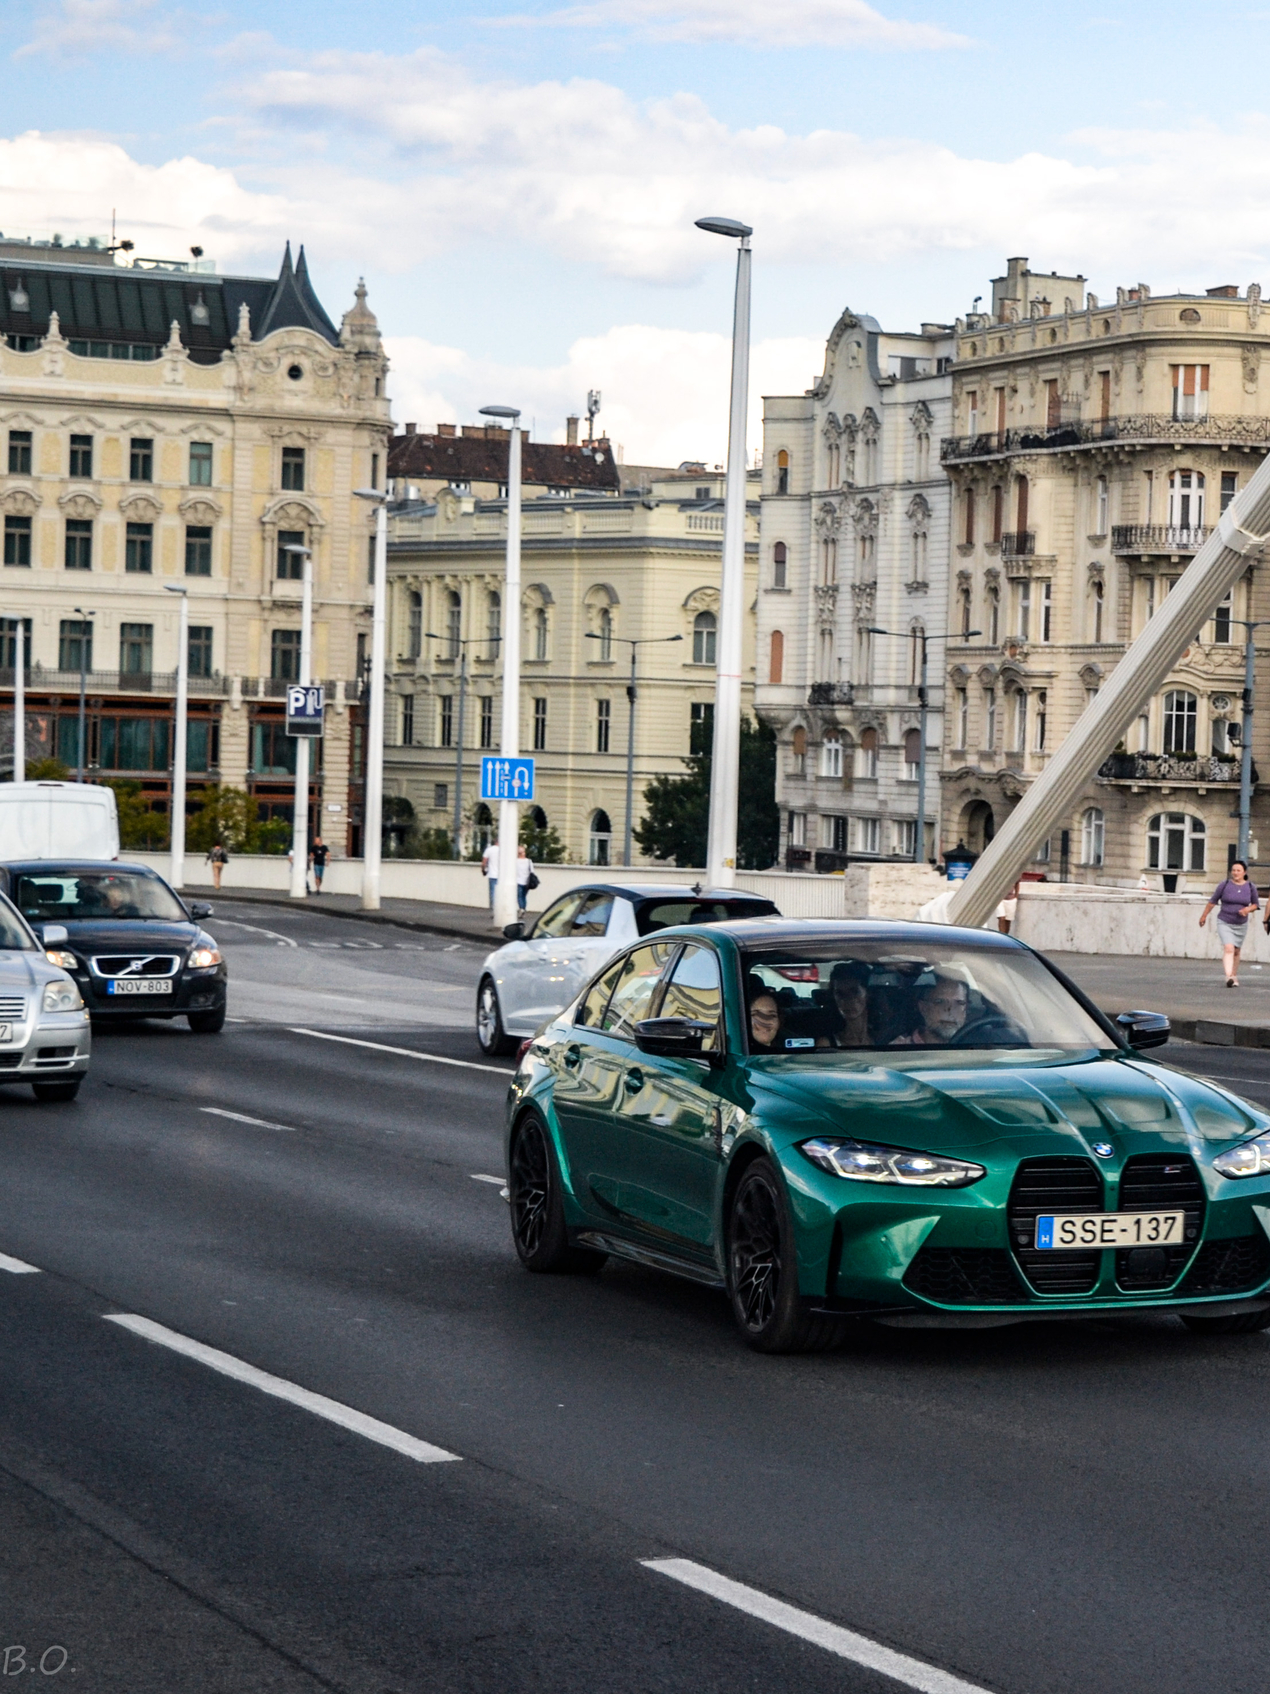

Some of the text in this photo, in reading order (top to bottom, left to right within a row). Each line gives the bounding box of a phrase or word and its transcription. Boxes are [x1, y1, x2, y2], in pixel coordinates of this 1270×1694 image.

[116, 981, 170, 993] NOV-803
[1041, 1216, 1177, 1244] H SSE-137
